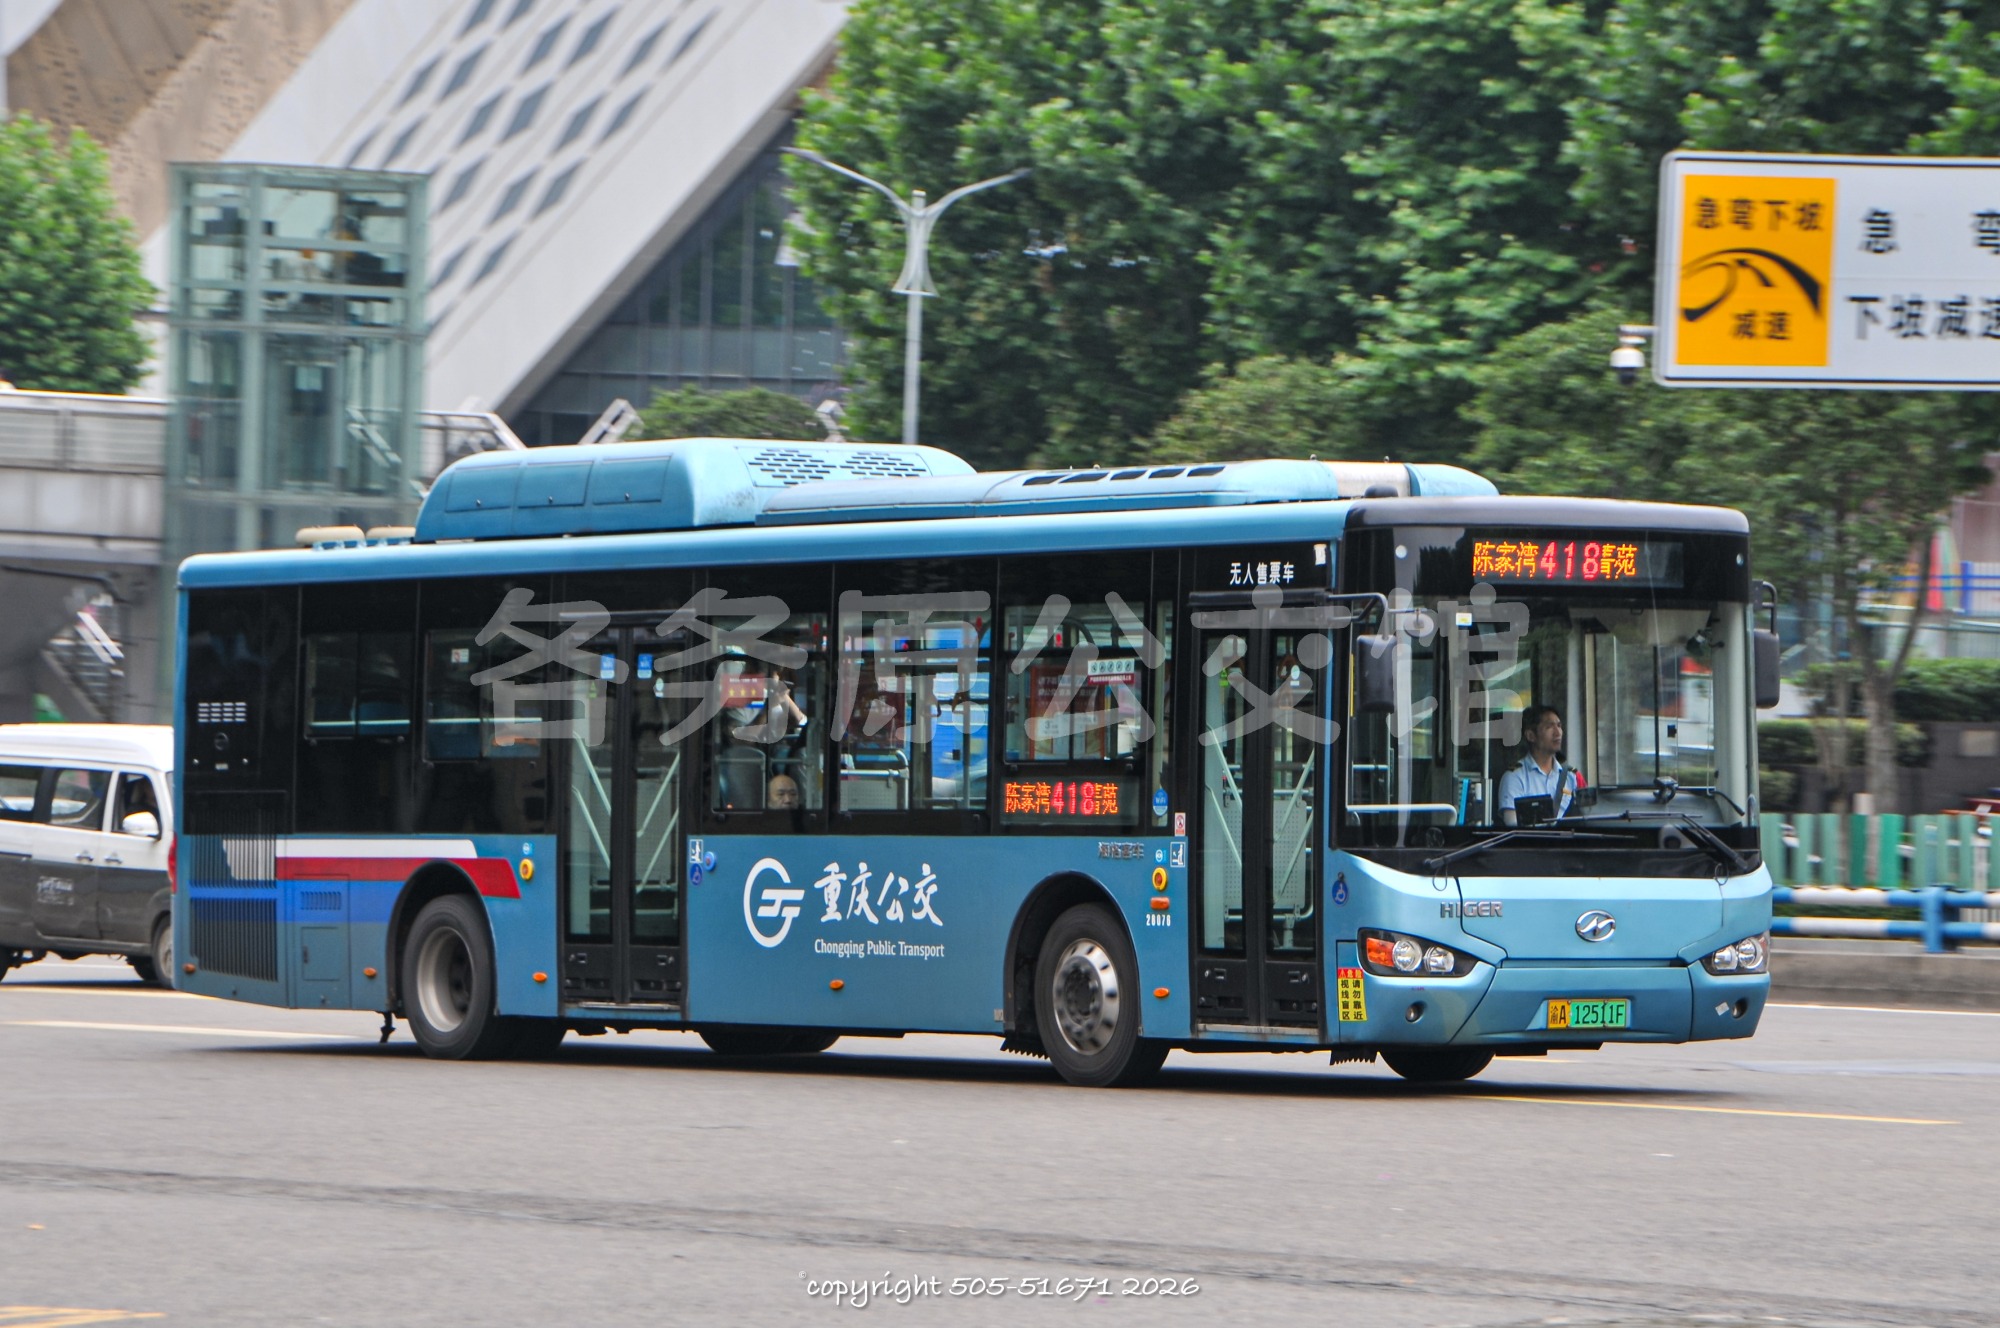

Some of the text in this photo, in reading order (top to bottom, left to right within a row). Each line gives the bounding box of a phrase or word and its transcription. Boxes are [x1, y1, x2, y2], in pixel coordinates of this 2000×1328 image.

[1694, 197, 1823, 231] 急弯下坡
[1732, 310, 1791, 340] 减速
[1229, 560, 1295, 585] 无人售票车
[1540, 541, 1600, 578] 418
[1052, 782, 1094, 815] 418
[814, 862, 943, 926] 重庆公交
[1440, 901, 1503, 918] HIGER
[814, 938, 945, 961] Chongqing Public Transport
[1341, 980, 1350, 1020] 视线盲区
[1352, 980, 1364, 1020] 请勿靠近
